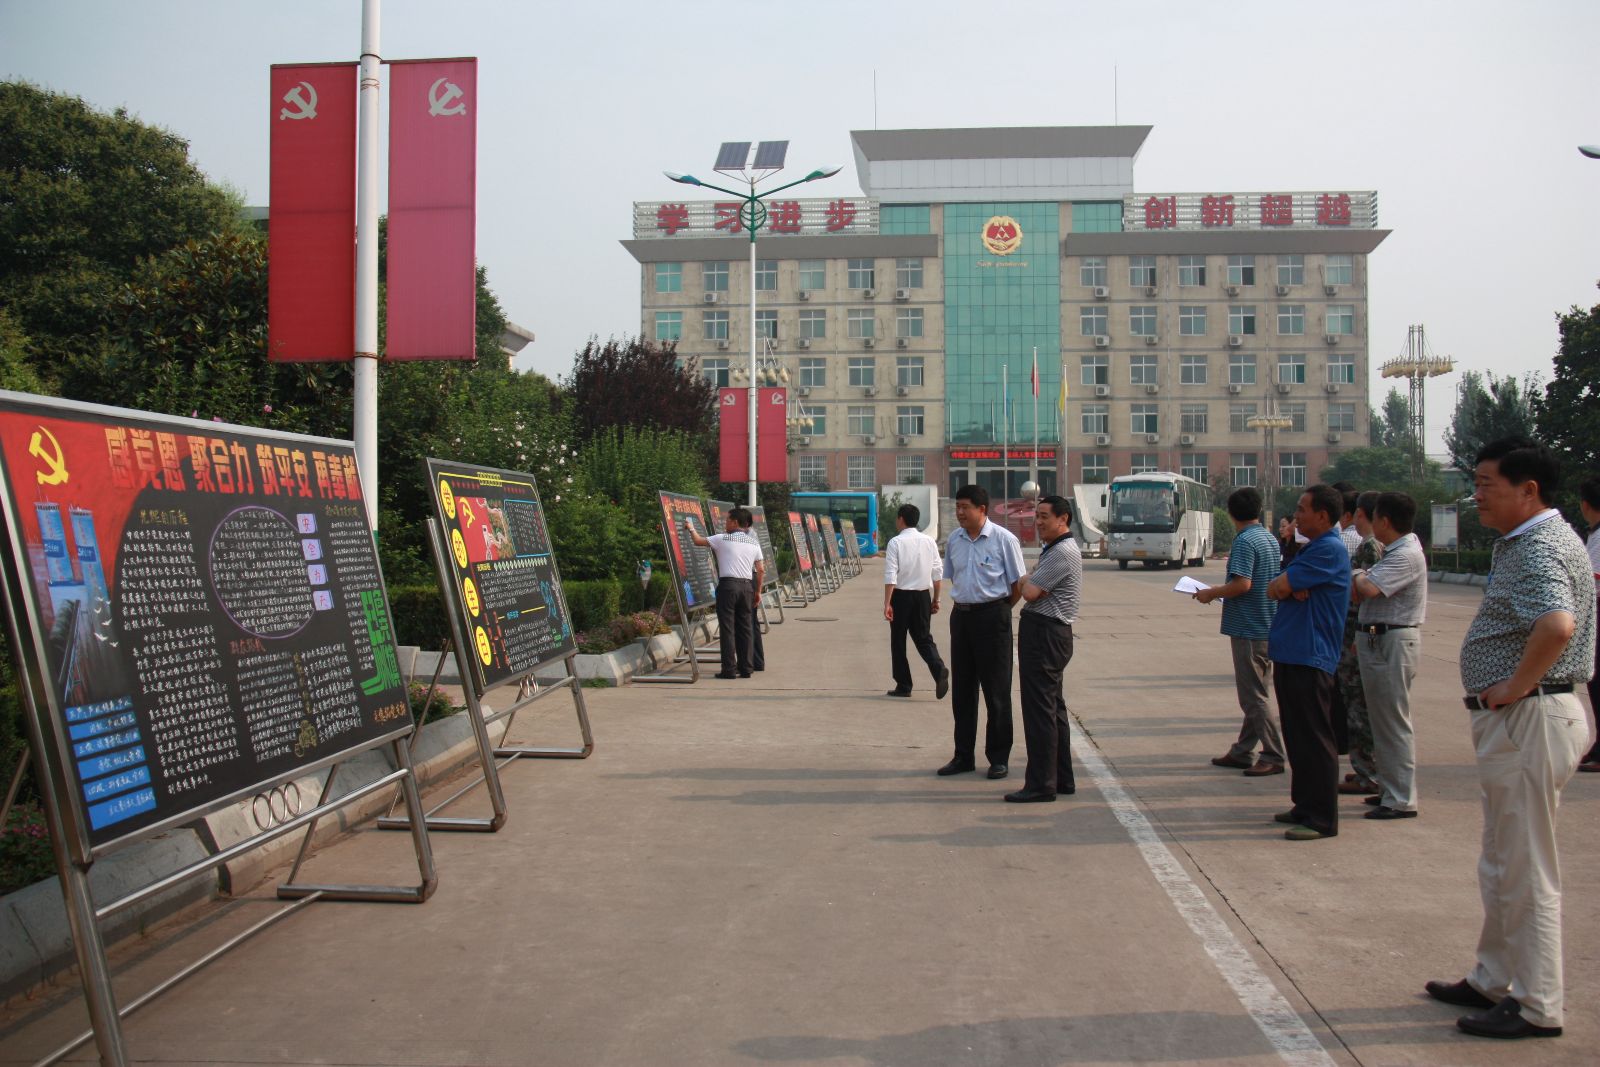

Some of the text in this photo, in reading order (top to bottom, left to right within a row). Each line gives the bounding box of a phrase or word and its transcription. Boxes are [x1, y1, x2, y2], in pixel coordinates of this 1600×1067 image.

[656, 199, 857, 235] 学习进步
[1144, 193, 1351, 229] 创新超越
[104, 426, 186, 491] 感党恩
[186, 435, 255, 495] 聚合力
[255, 443, 313, 498] 筑平安
